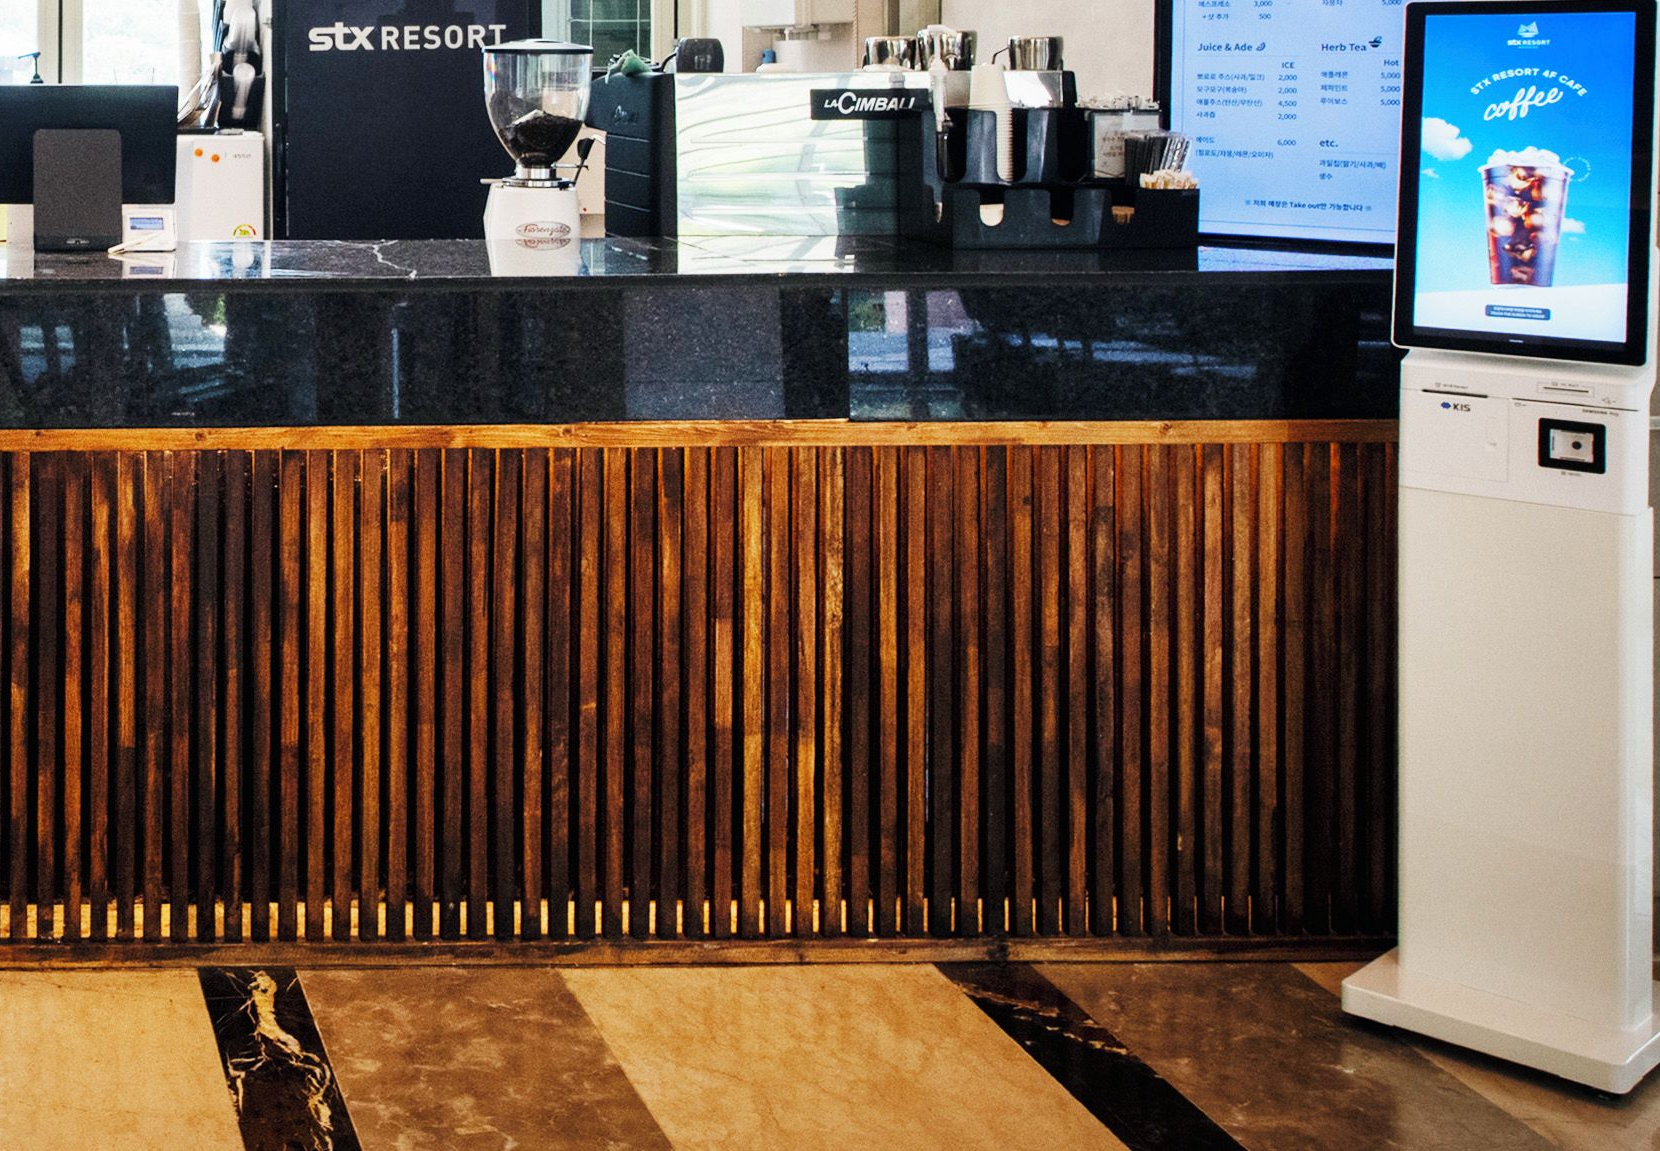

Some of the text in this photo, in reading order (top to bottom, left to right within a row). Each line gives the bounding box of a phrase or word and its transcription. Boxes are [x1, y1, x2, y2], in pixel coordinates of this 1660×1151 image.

[308, 21, 508, 51] stx RESORT
[1198, 43, 1253, 51] Juice & Ade
[1321, 43, 1367, 52] Herb Tea
[1470, 67, 1588, 97] STX RESORT 4F CAFE
[824, 99, 838, 108] LA
[1483, 85, 1564, 121] coffee
[1319, 139, 1339, 147] etc.
[1289, 201, 1306, 209] Take
[1453, 403, 1471, 412] KIS
